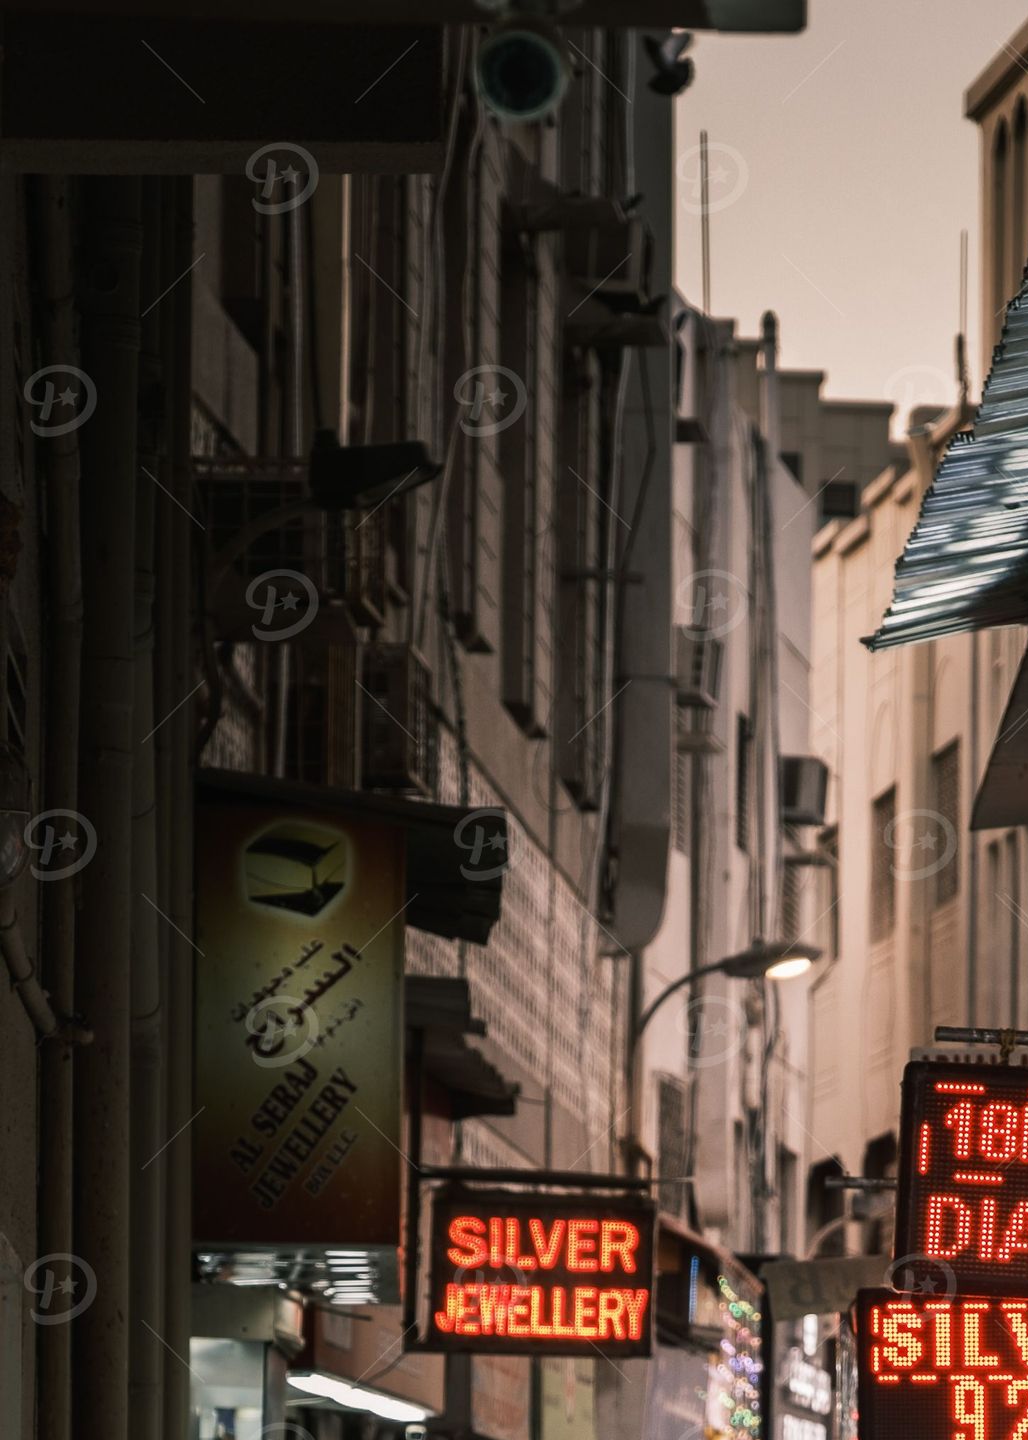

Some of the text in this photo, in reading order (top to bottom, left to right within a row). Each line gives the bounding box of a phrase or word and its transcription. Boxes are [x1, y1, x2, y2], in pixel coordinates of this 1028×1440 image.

[229, 1057, 318, 1173] AL SERAJ
[251, 1067, 358, 1208] JEWELLERY
[447, 1215, 640, 1273] SILVER
[435, 1283, 649, 1340] JEWELLERY
